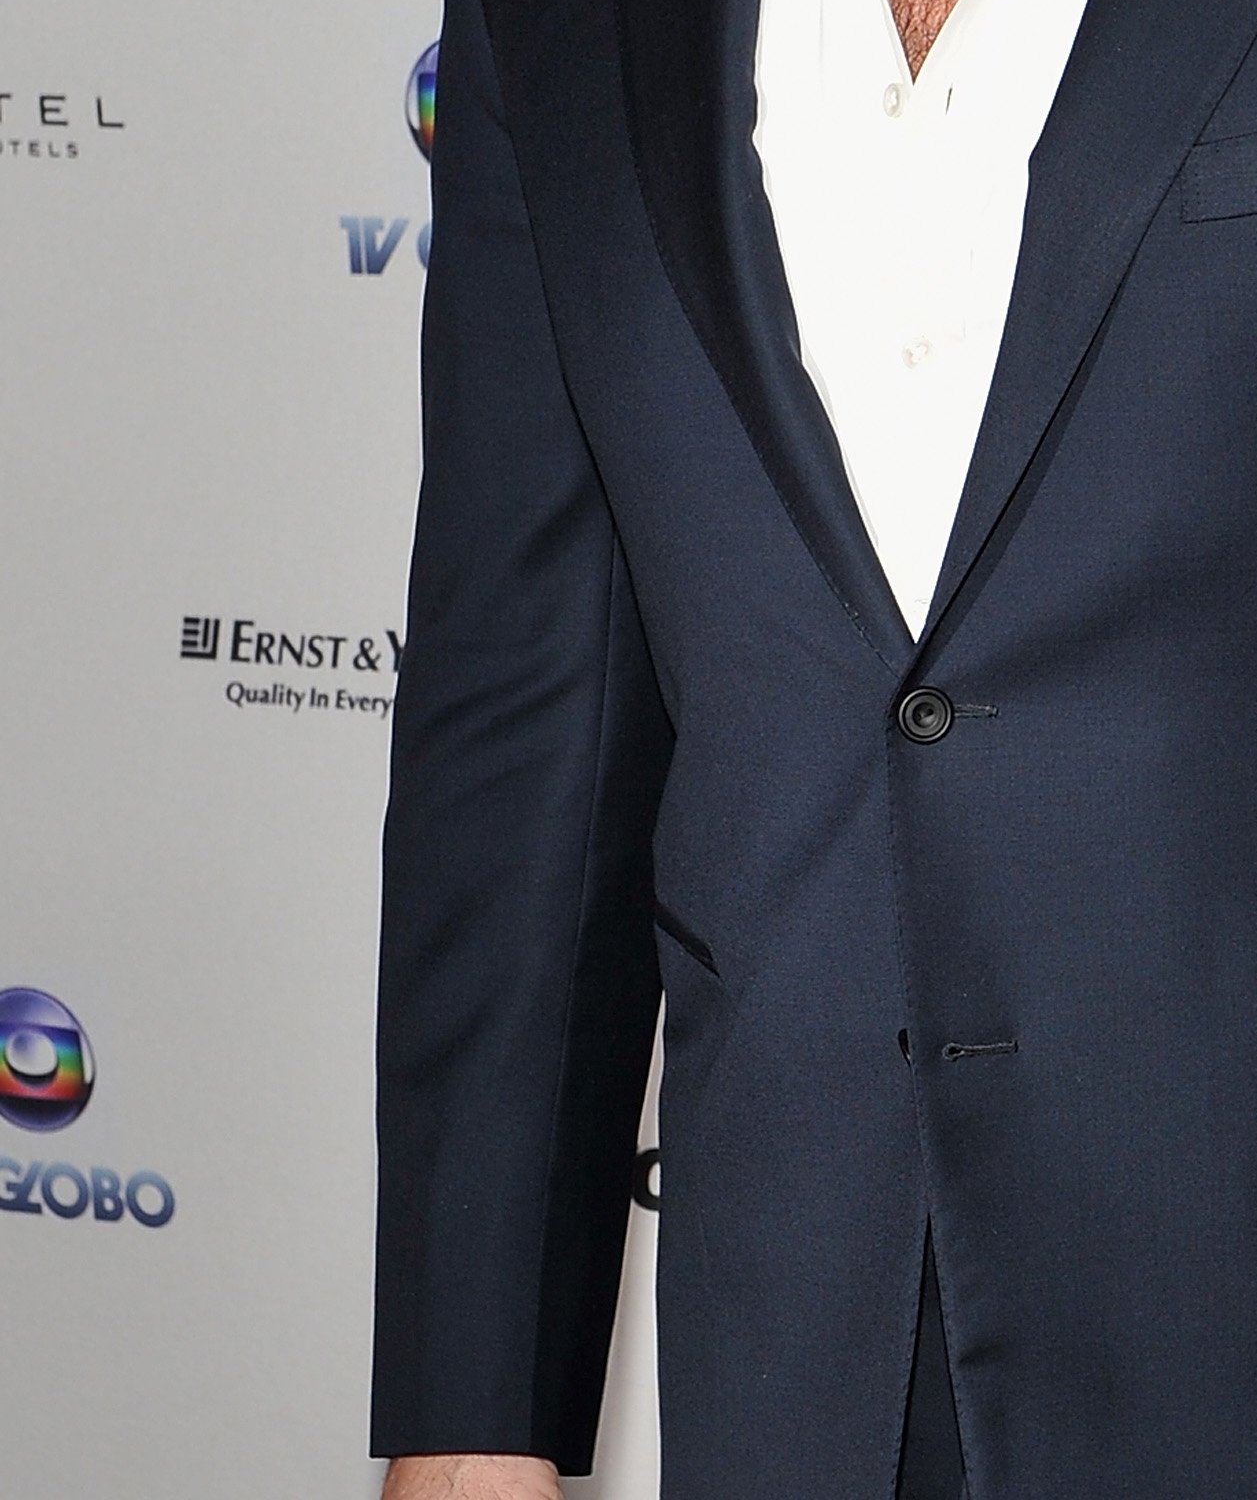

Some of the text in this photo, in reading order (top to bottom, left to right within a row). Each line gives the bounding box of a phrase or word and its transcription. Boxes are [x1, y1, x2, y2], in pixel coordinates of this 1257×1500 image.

[0, 140, 78, 158] TELS
[230, 620, 346, 669] ERNST
[352, 637, 381, 671] &
[226, 682, 304, 714] Quality
[309, 689, 328, 708] In
